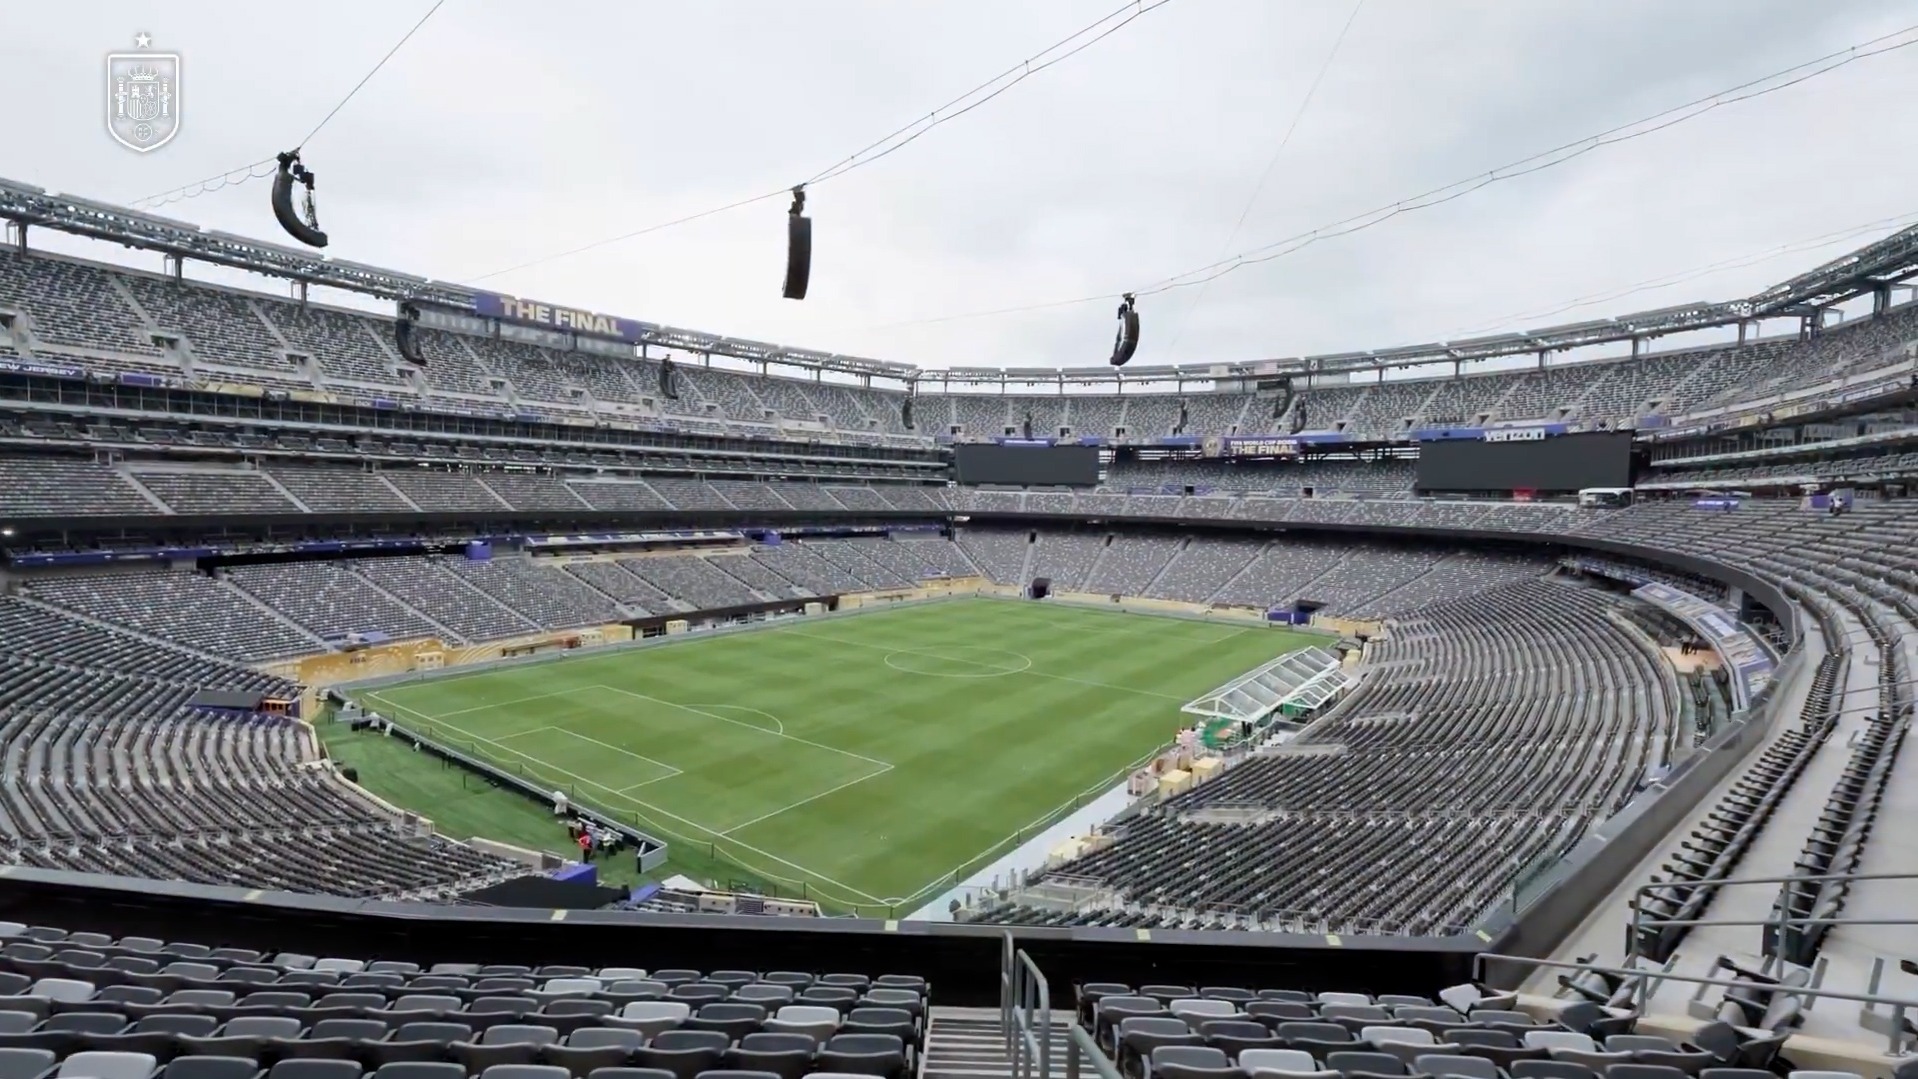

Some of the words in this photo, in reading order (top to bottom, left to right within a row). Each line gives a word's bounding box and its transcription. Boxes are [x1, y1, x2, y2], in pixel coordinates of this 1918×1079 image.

[500, 297, 550, 324] THE
[554, 308, 624, 337] FINAL
[23, 365, 76, 376] JERSEY
[1230, 445, 1256, 455] THE
[1257, 445, 1298, 455] FINAL
